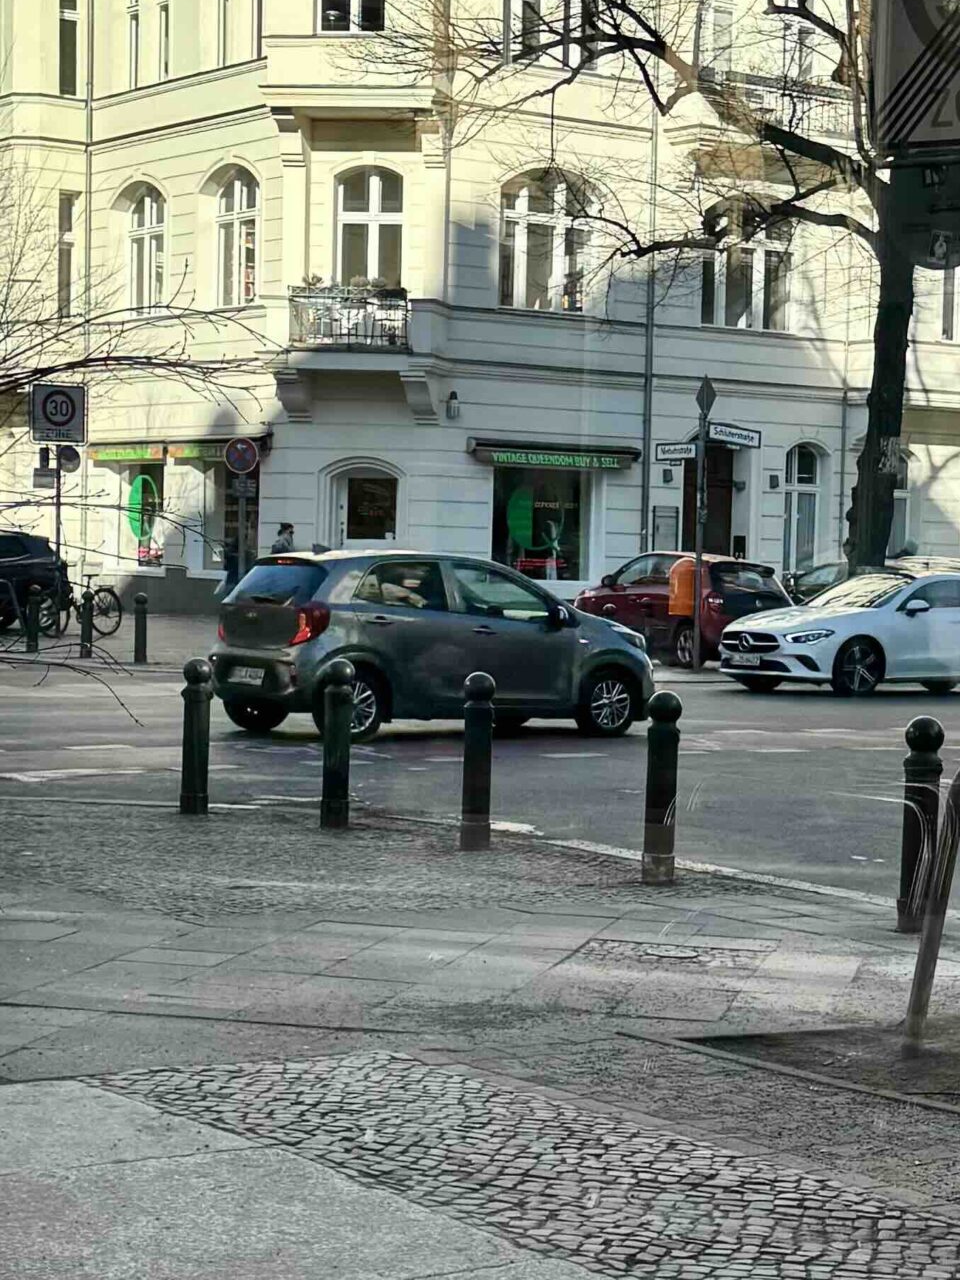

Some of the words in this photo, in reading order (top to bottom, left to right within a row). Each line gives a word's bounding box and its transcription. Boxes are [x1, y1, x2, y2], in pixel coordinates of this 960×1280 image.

[49, 399, 69, 417] 30
[491, 452, 527, 464] VINTAGE
[528, 455, 574, 466] QUEENDOM
[575, 456, 591, 468] BUY
[601, 458, 620, 468] SELL
